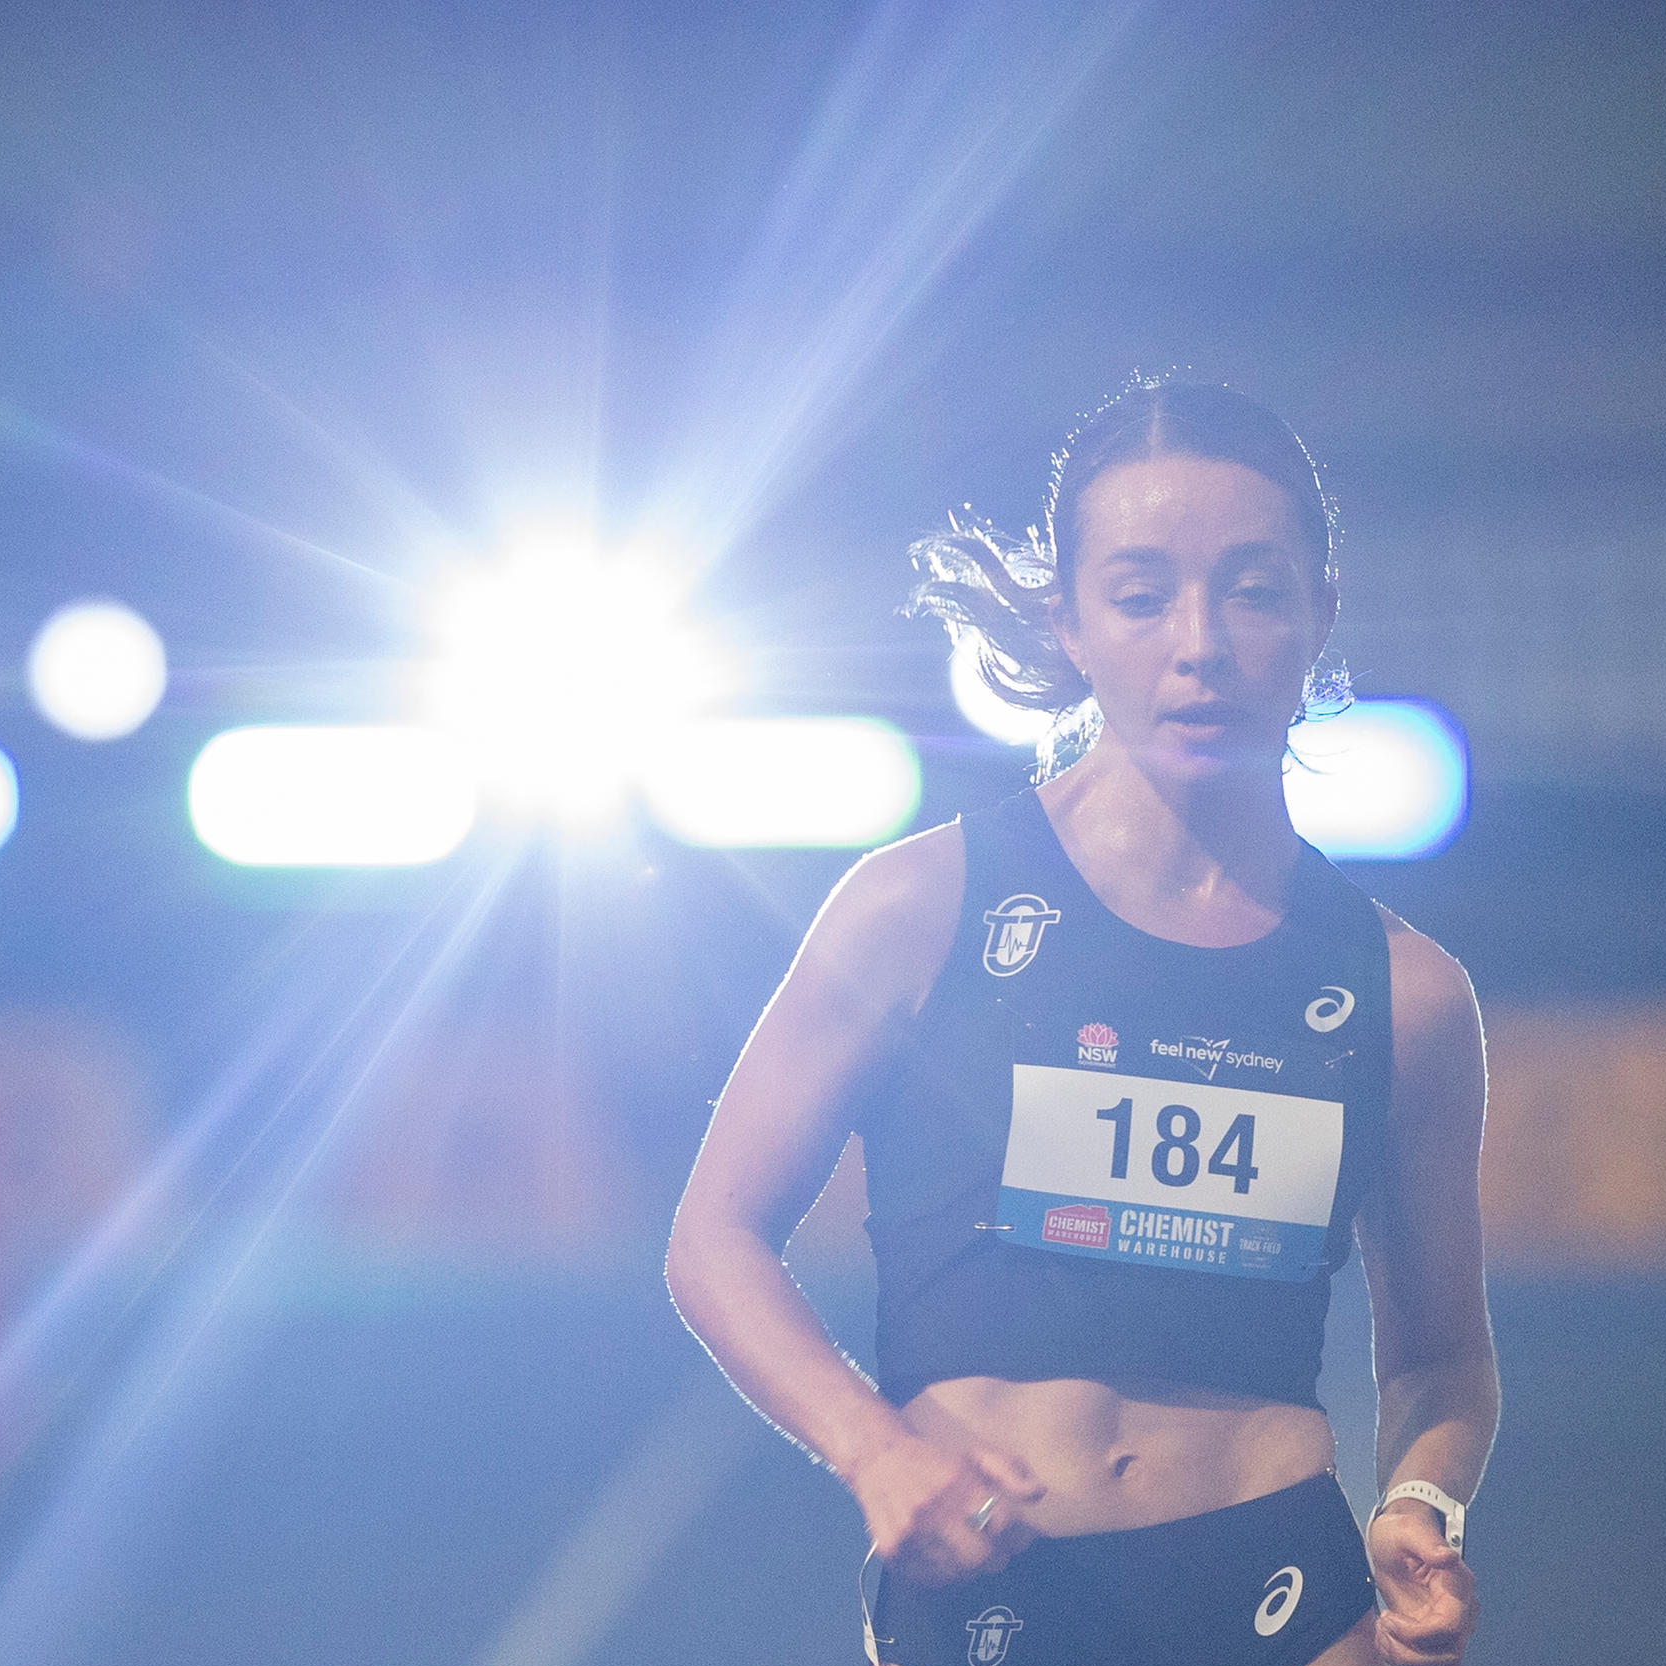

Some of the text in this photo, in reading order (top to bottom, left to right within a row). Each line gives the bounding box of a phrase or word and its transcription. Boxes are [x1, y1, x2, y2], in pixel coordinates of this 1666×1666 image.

[1078, 1046, 1118, 1063] NSW
[1150, 1039, 1284, 1074] feel new sydney
[1096, 1097, 1259, 1195] 184
[1048, 1215, 1107, 1235] CHEMIST
[1119, 1209, 1235, 1248] CHEMIST
[1117, 1239, 1227, 1265] WAREHOUSE
